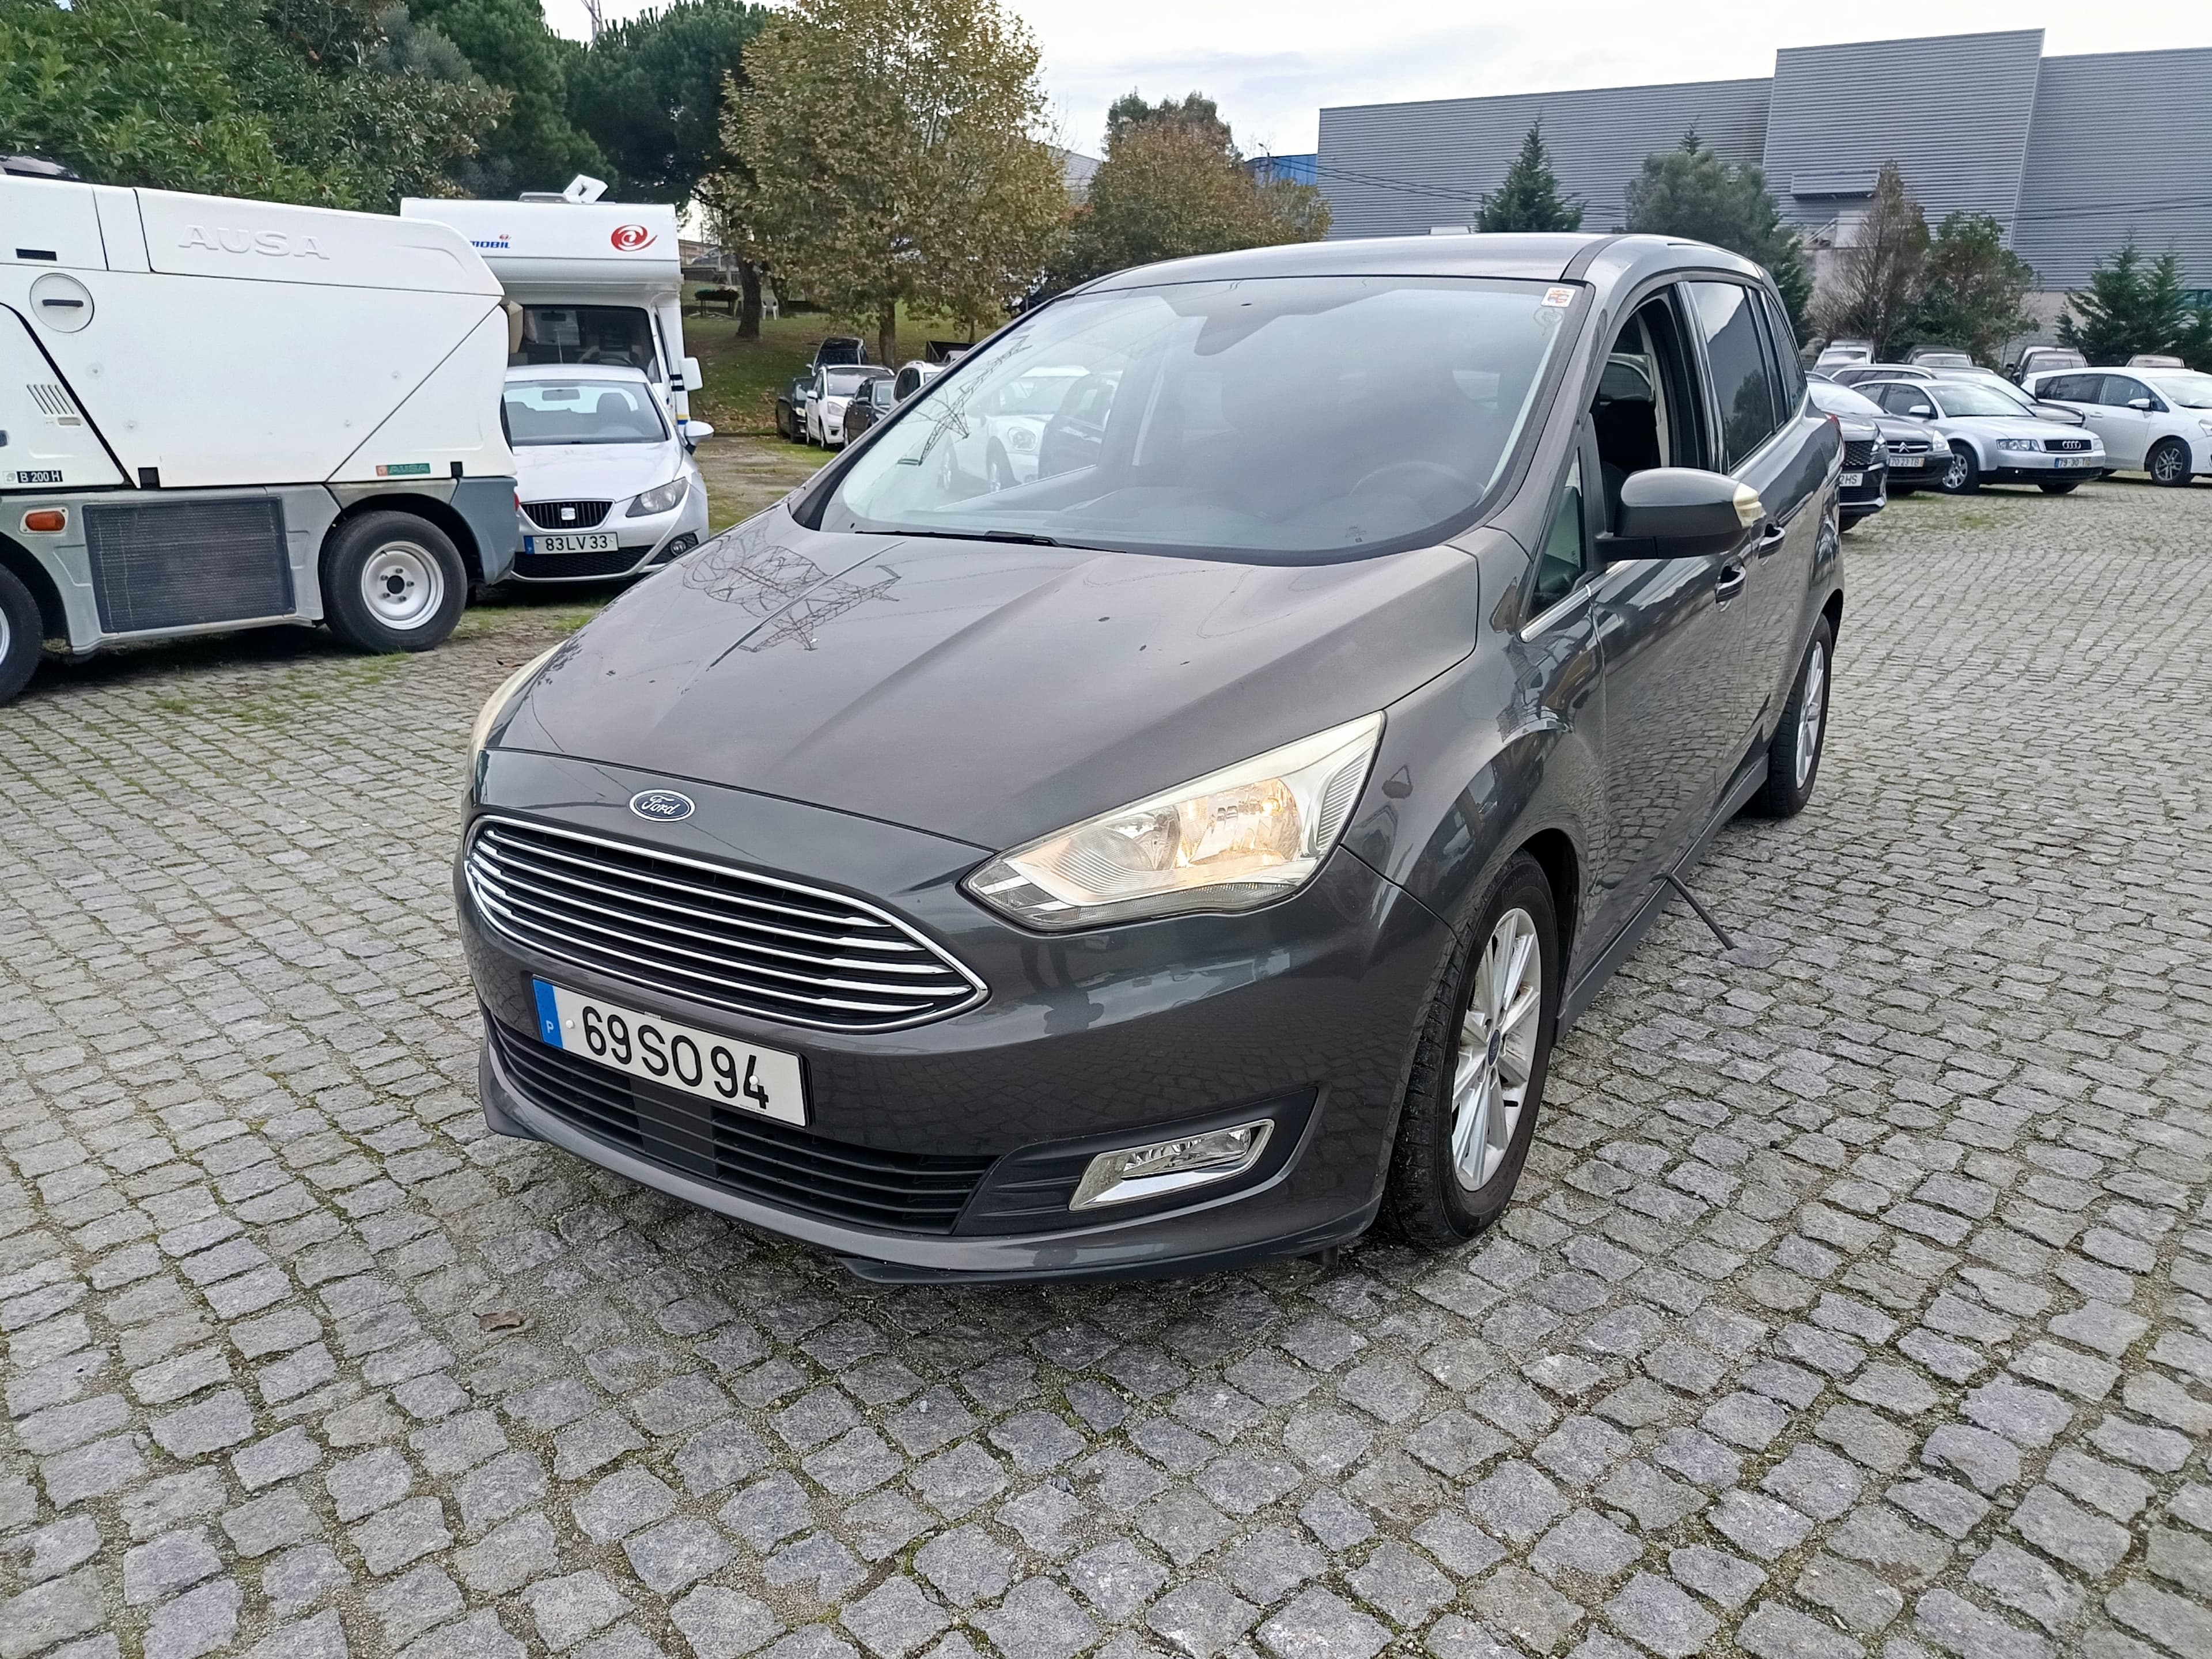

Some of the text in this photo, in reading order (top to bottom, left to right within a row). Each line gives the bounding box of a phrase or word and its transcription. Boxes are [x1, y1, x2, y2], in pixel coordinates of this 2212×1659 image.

[178, 224, 330, 260] AUSA
[20, 471, 60, 482] B 200 H
[389, 464, 430, 474] AUSA
[641, 795, 681, 815] Ford
[546, 1020, 555, 1035] P
